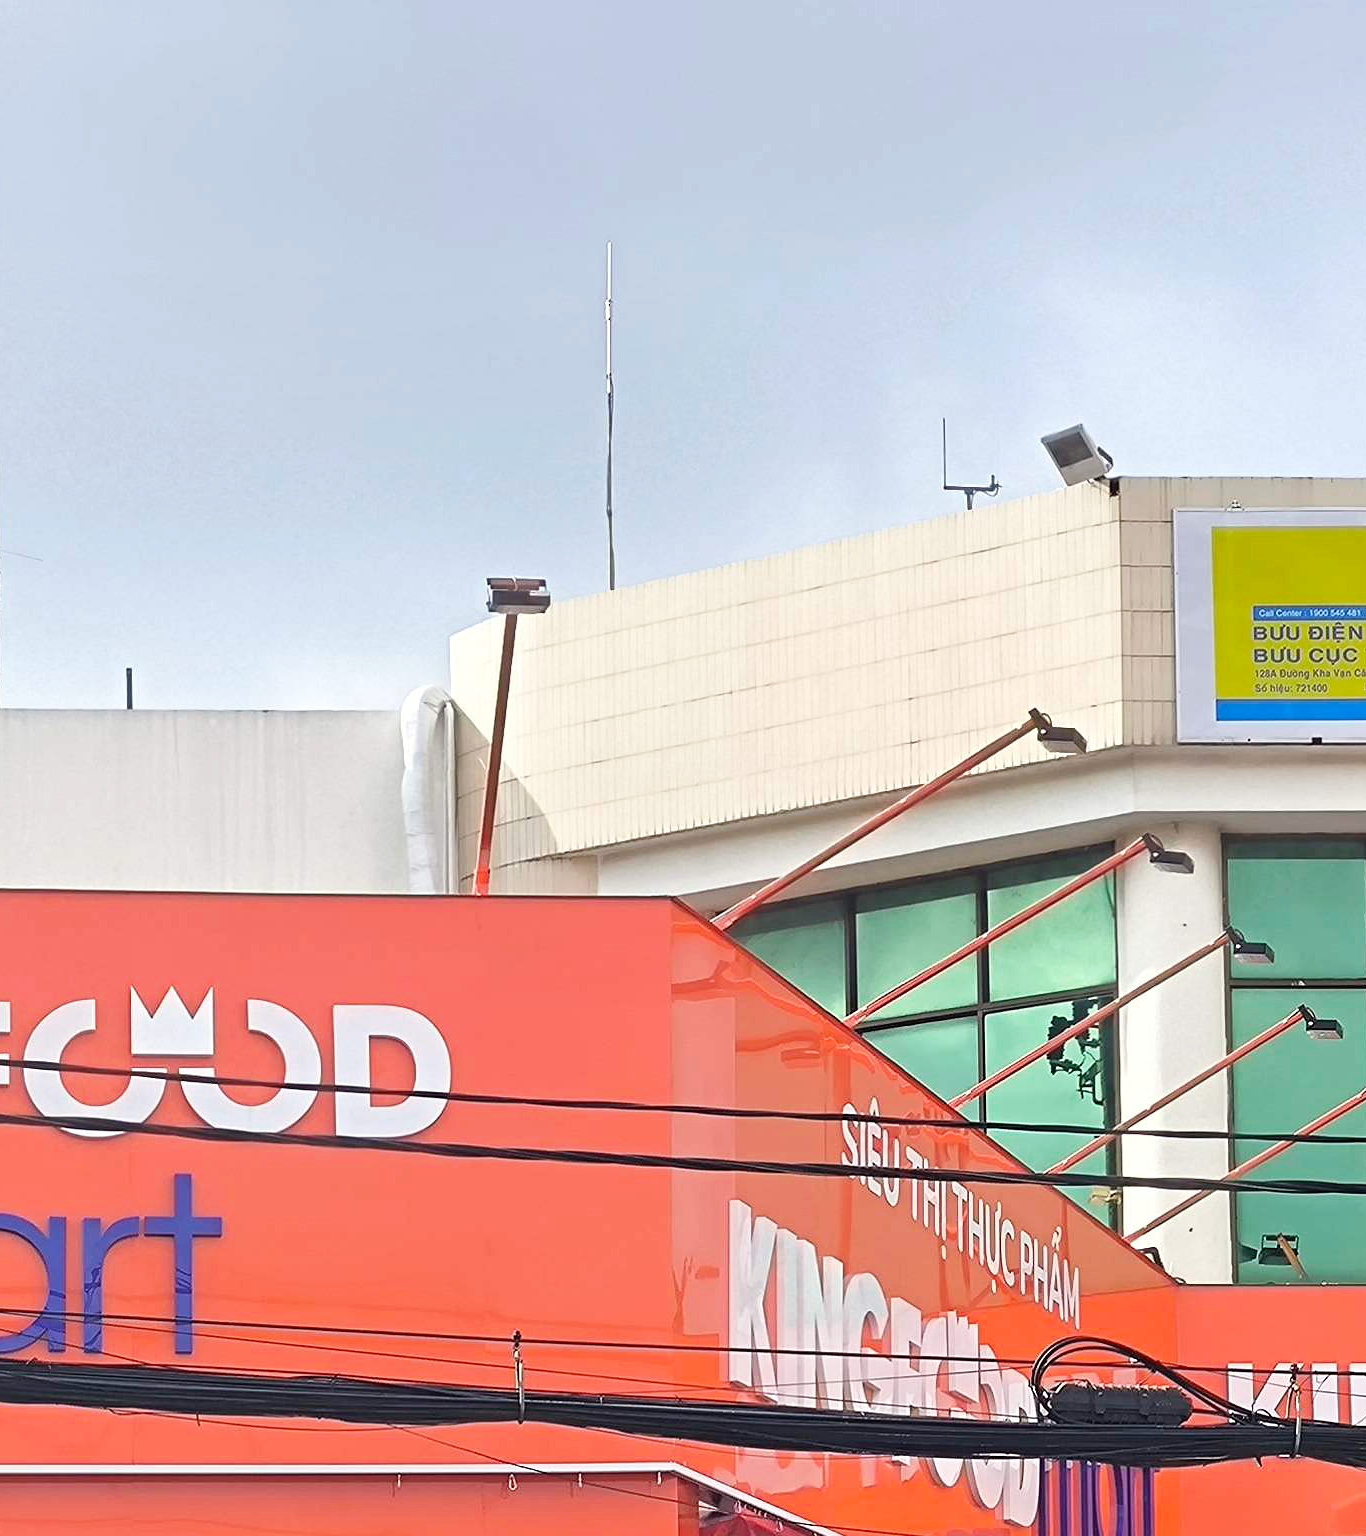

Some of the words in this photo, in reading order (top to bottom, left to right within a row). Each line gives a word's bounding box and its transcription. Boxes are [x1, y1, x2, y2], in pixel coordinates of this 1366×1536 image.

[1259, 609, 1274, 618] Call
[1276, 609, 1302, 618] Center
[1309, 609, 1329, 617] 1900
[1254, 624, 1301, 640] BƯU
[1308, 622, 1363, 644] ĐIỆN
[1254, 647, 1301, 663] BƯU
[1309, 648, 1358, 665] CỤC
[1255, 669, 1277, 678] 128A
[1312, 668, 1331, 678] Kha
[1296, 683, 1327, 692] 721400
[842, 1097, 900, 1207] SIÊU
[905, 1150, 948, 1260] THỊ
[952, 1183, 1015, 1293] THỰC
[1020, 1226, 1081, 1329] PHẨM
